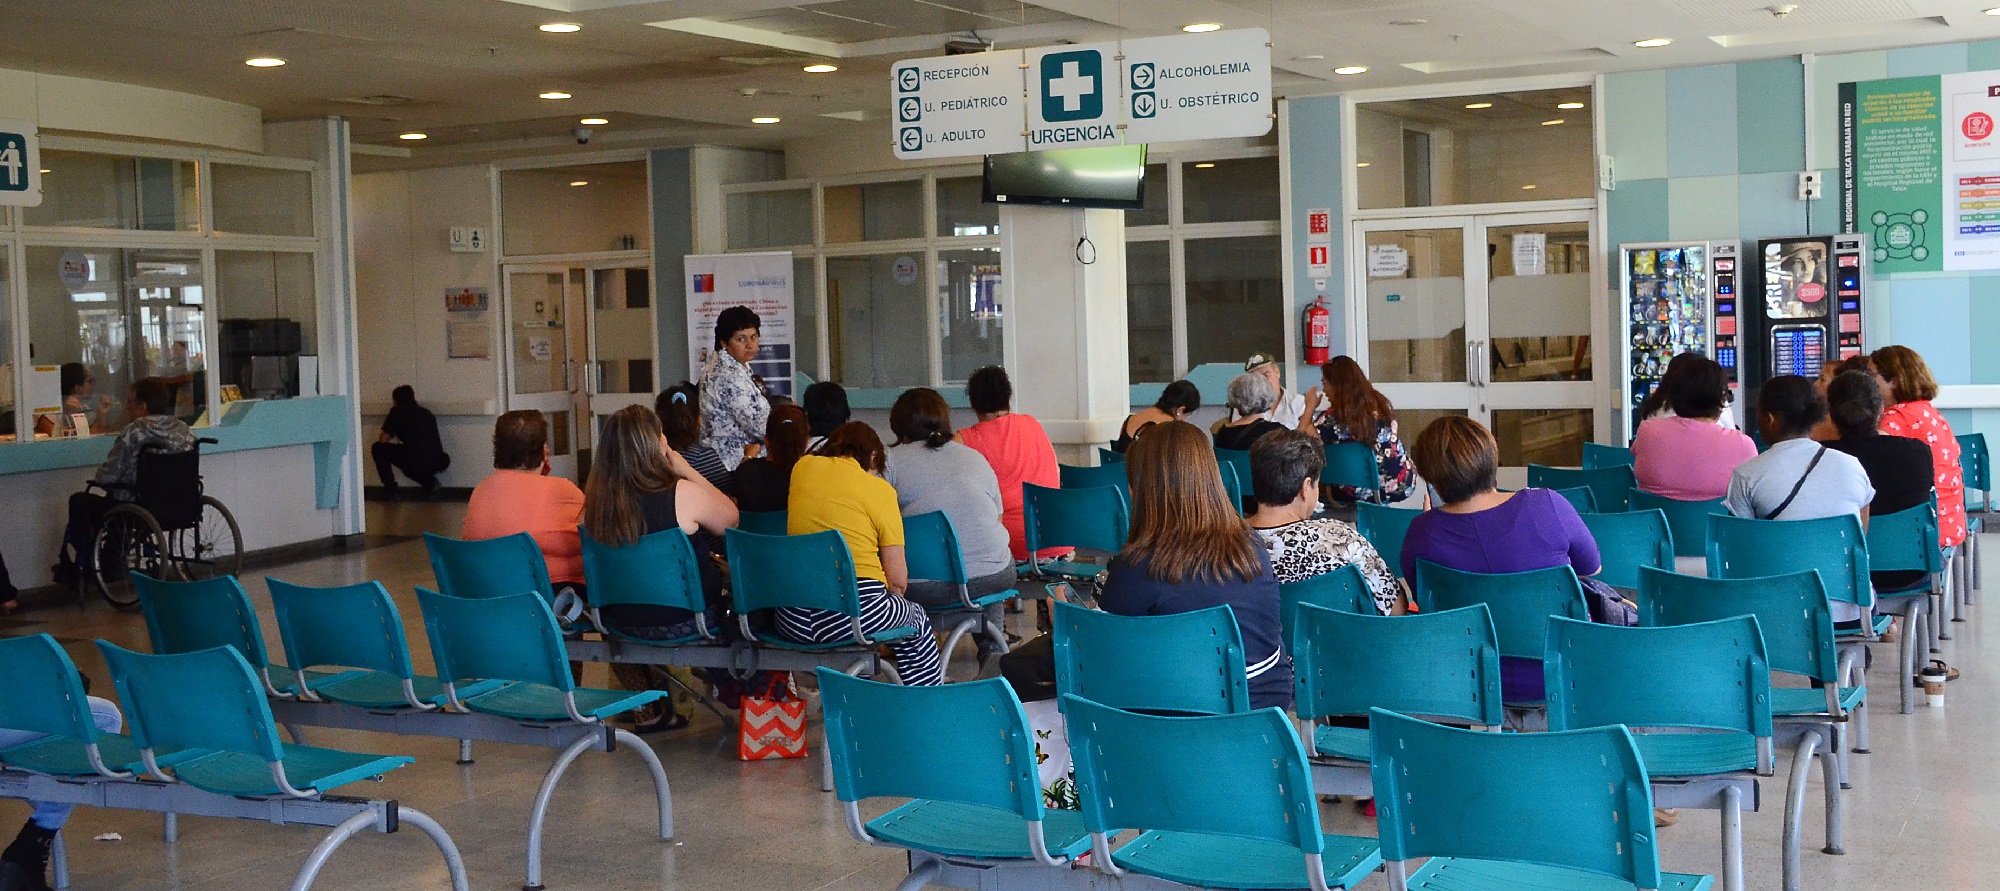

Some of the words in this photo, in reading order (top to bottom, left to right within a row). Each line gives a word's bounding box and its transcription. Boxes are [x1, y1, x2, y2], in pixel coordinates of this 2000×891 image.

[924, 64, 989, 81] RECEPCIÓN
[1159, 62, 1251, 79] ALCOHOLEMIA
[925, 102, 936, 112] U.
[941, 96, 1008, 111] PEDIÁTRICO
[1160, 99, 1172, 109] U.
[1178, 91, 1259, 108] OBSTÉTRICO
[1844, 102, 1852, 116] RED
[1844, 117, 1852, 127] EN
[925, 133, 937, 143] U.
[941, 129, 986, 142] ADULTO
[1031, 124, 1115, 144] URGENCIA
[1844, 127, 1852, 157] TRABAJA
[1845, 178, 1852, 189] DE
[1845, 189, 1853, 222] REGIONAL
[1800, 287, 1820, 297] $500
